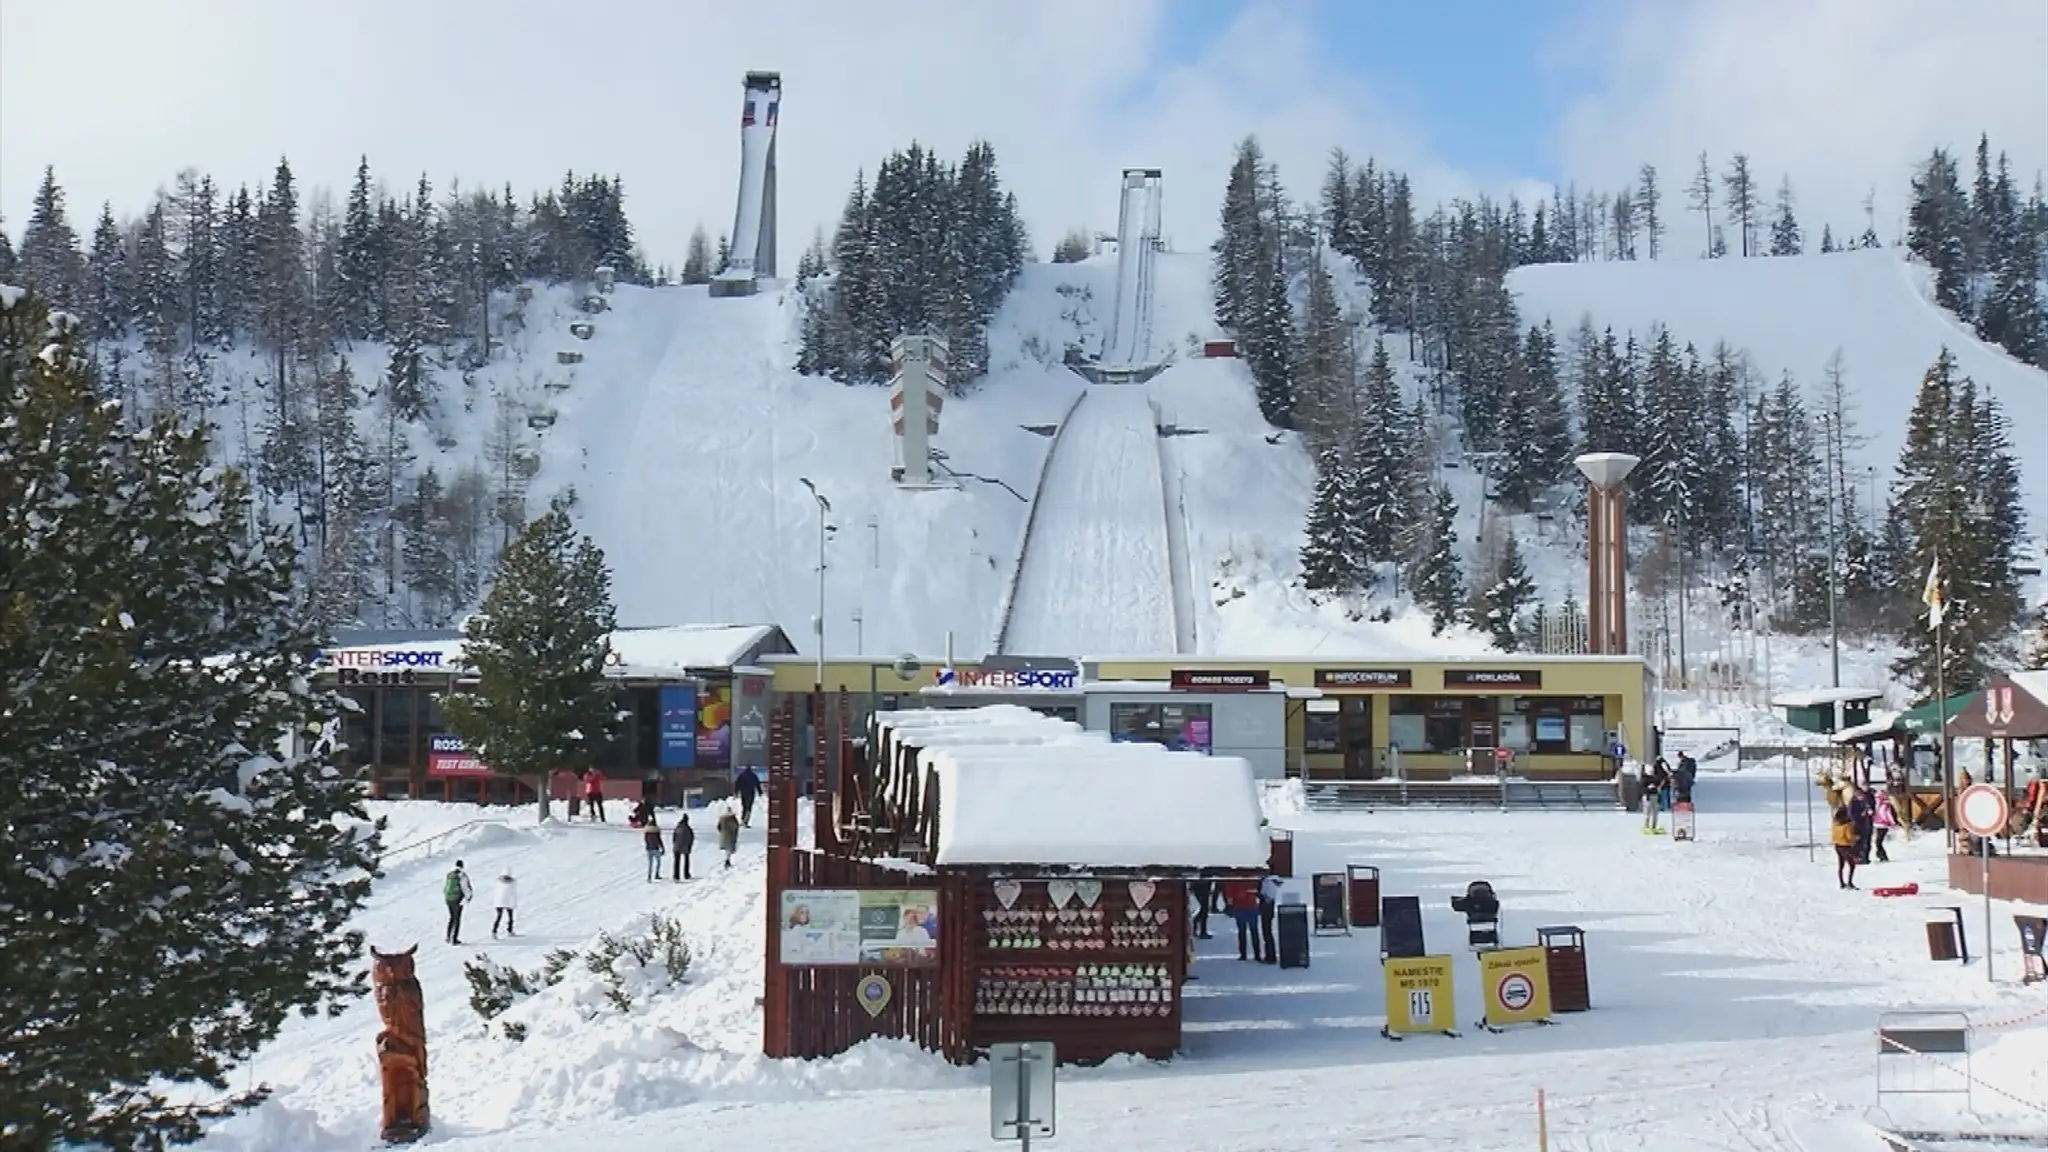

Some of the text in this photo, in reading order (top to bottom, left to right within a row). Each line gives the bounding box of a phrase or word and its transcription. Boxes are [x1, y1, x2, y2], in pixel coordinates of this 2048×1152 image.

[332, 651, 442, 666] NTERSPORT
[338, 668, 416, 683] Rent
[958, 671, 1076, 688] INTERSPORT
[1334, 672, 1398, 682] INFOCENTRUM
[433, 739, 464, 750] ROSS
[1411, 992, 1430, 1015] FIS
